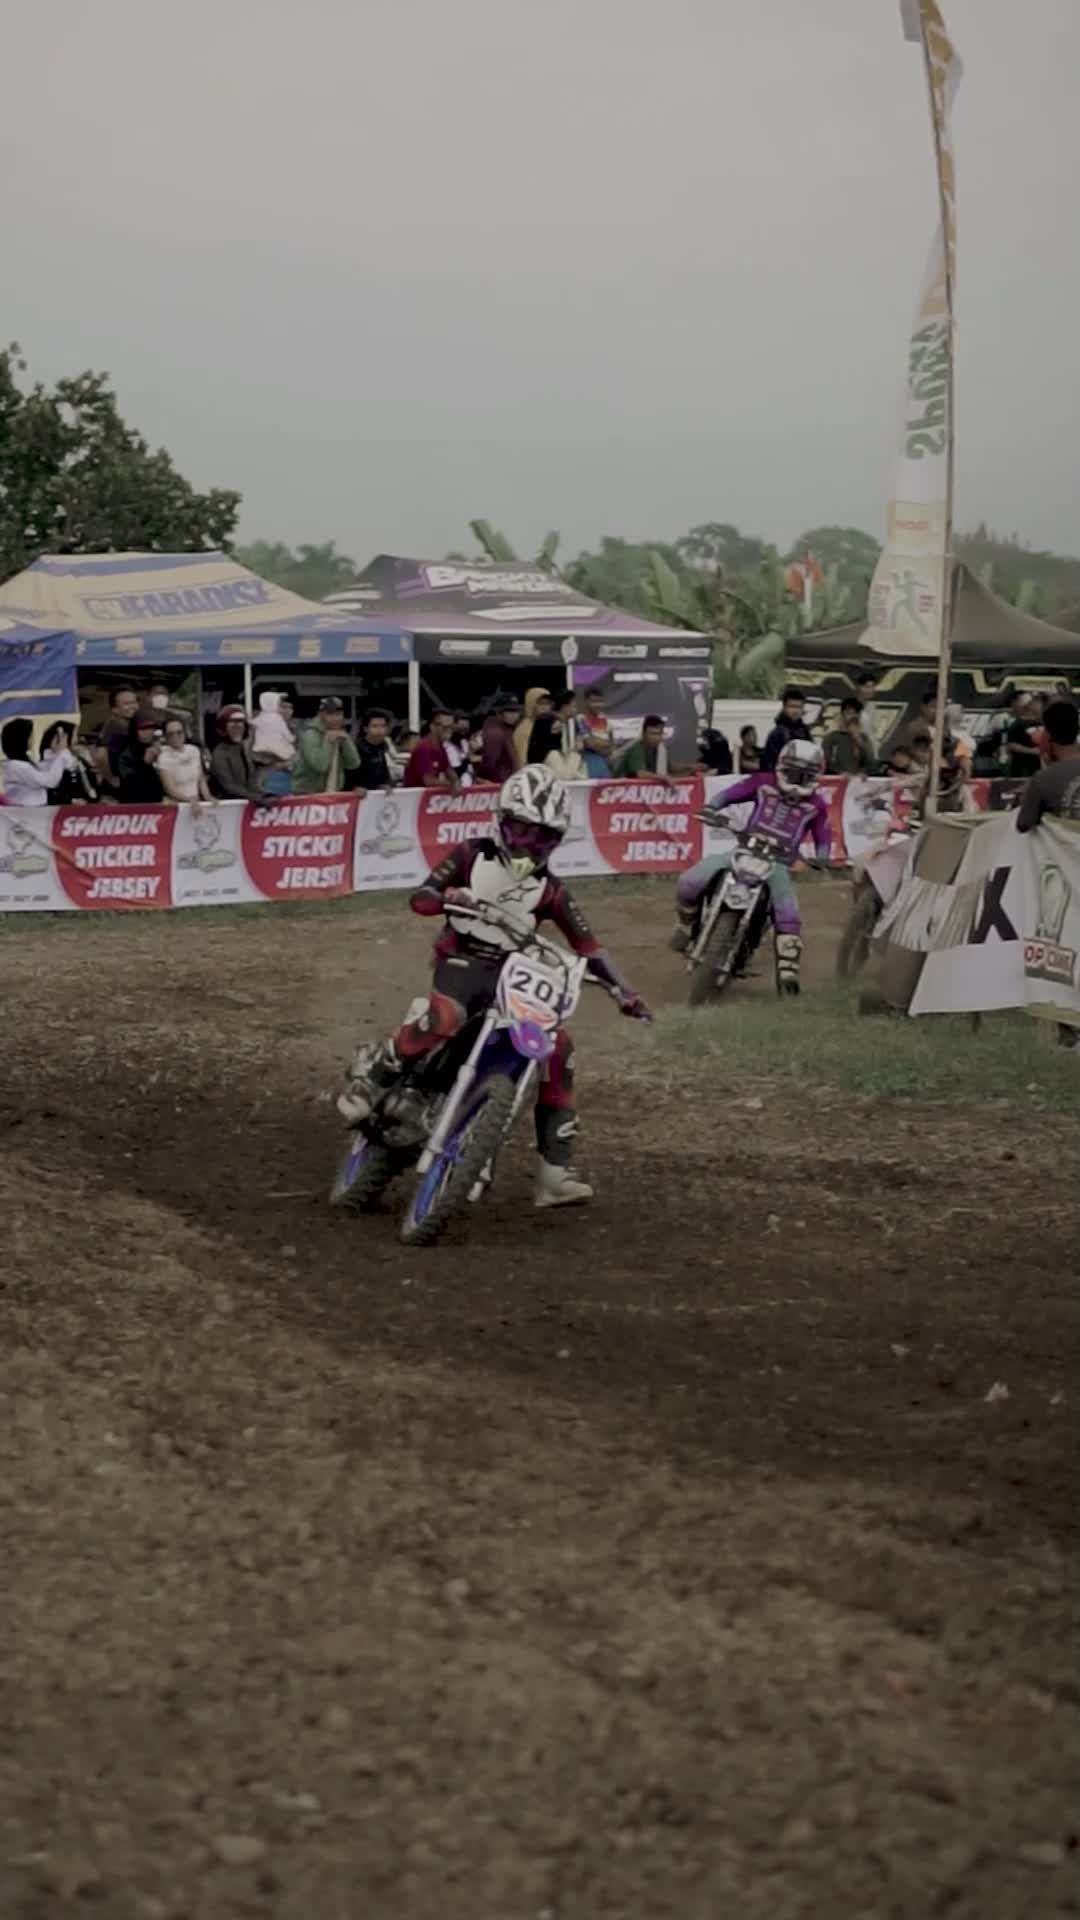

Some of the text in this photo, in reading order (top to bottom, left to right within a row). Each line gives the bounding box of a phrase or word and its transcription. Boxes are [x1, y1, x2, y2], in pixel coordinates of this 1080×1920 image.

[426, 792, 498, 814] SPANDU
[597, 784, 694, 805] SPANDUK
[61, 814, 162, 838] SPANDUK
[250, 803, 350, 828] SPANDUK
[608, 813, 688, 833] STICKER
[75, 844, 156, 868] STICKER
[622, 841, 693, 862] JERSEY
[87, 875, 160, 900] JERSEY
